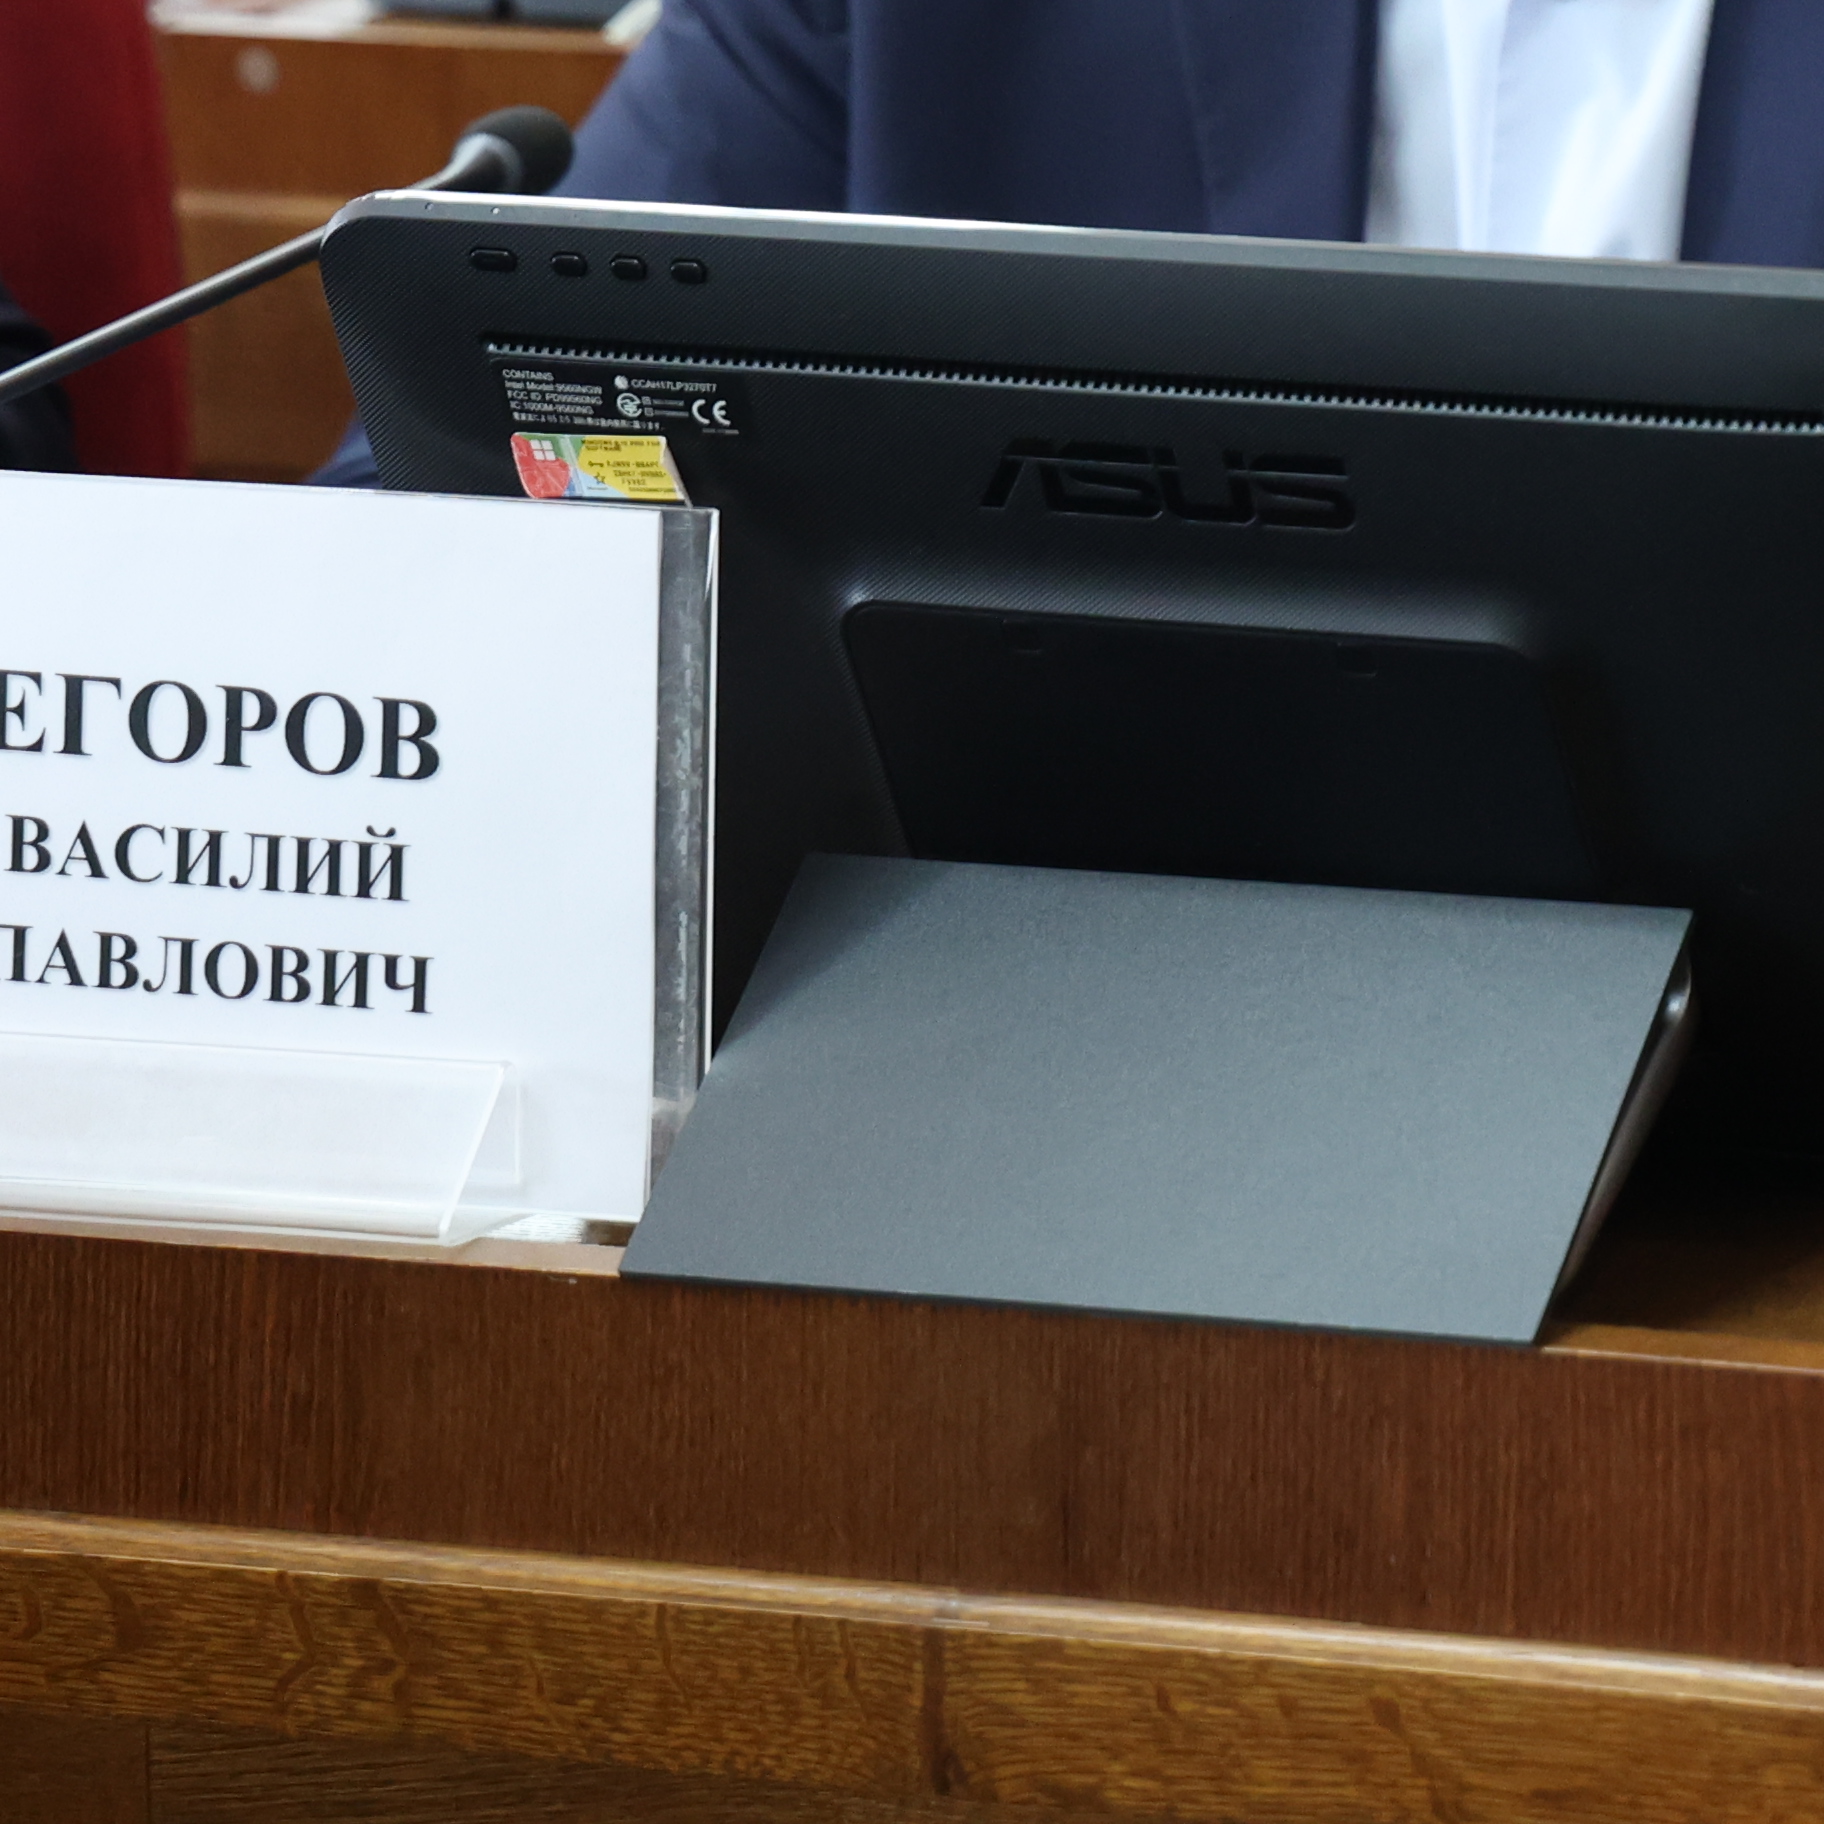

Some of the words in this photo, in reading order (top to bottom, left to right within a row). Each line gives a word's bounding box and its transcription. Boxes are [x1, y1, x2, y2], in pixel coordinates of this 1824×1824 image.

[980, 437, 1356, 533] ASUS
[0, 669, 440, 780] ЕГОРОВ
[4, 814, 411, 903] ВАСИЛИЙ
